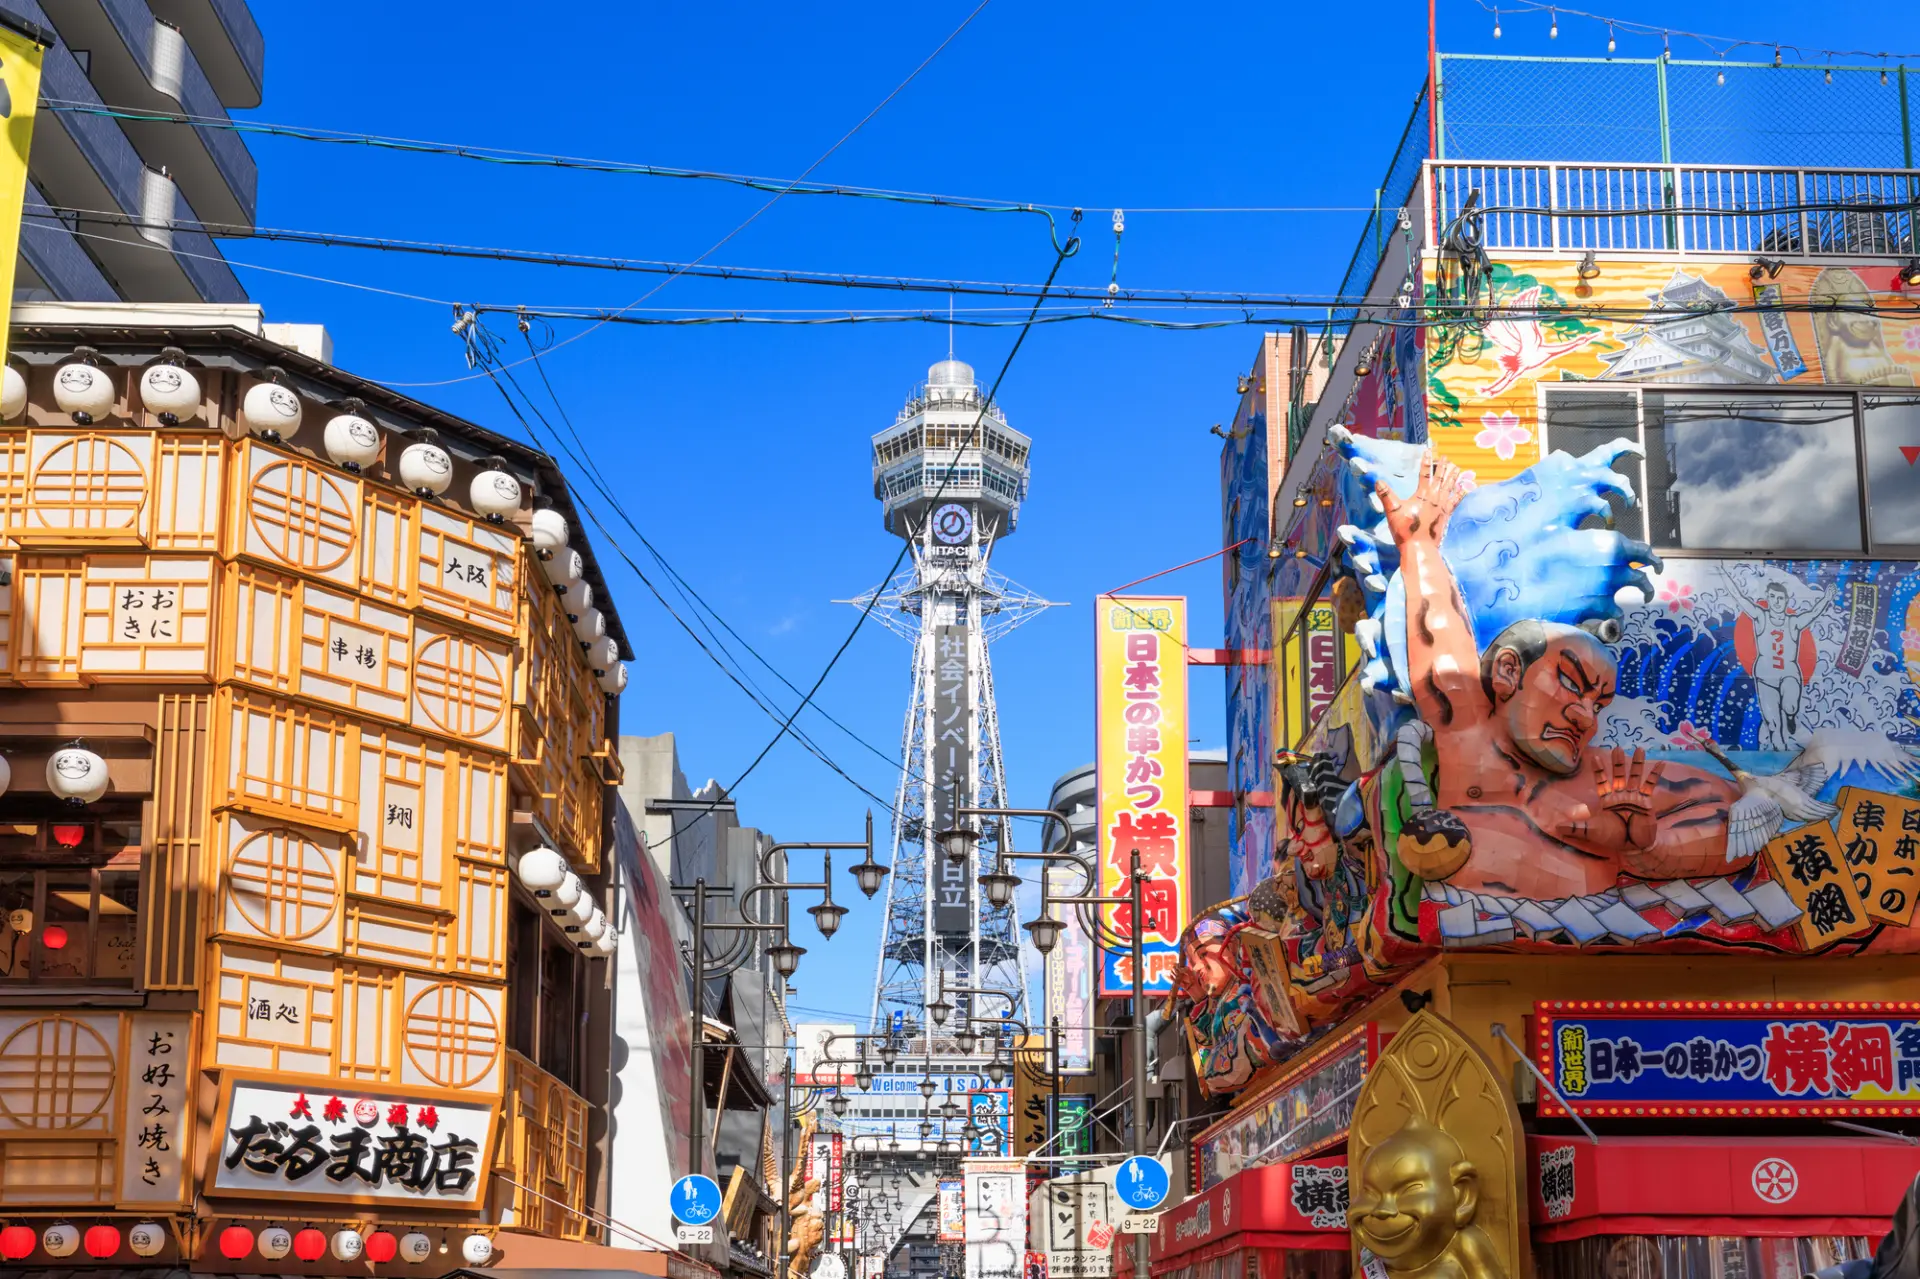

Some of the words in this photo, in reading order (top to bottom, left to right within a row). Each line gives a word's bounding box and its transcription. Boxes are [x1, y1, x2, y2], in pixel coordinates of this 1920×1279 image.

[931, 546, 971, 556] HITACH
[445, 557, 487, 589] 大阪
[1112, 608, 1172, 630] 新世界
[331, 637, 377, 669] 串揚
[1125, 634, 1162, 808] 日本一の串かつ
[387, 803, 413, 829] 翔
[1845, 800, 1886, 899] 串かつ
[1111, 812, 1178, 943] 横綱
[1785, 834, 1856, 936] 横綱
[249, 996, 300, 1025] 酒処
[1563, 1029, 1586, 1093] 新世界
[1589, 1036, 1763, 1081] 日本一の串かつ
[1766, 1026, 1893, 1094] 横綱
[872, 1078, 917, 1092] Welcome
[138, 1031, 176, 1186] お好み焼き
[290, 1093, 346, 1122] 大衆
[386, 1103, 440, 1129] 酒場
[225, 1114, 479, 1195] だるま商店
[1295, 1167, 1348, 1178] 日本一の
[1542, 1161, 1574, 1204] 横綱
